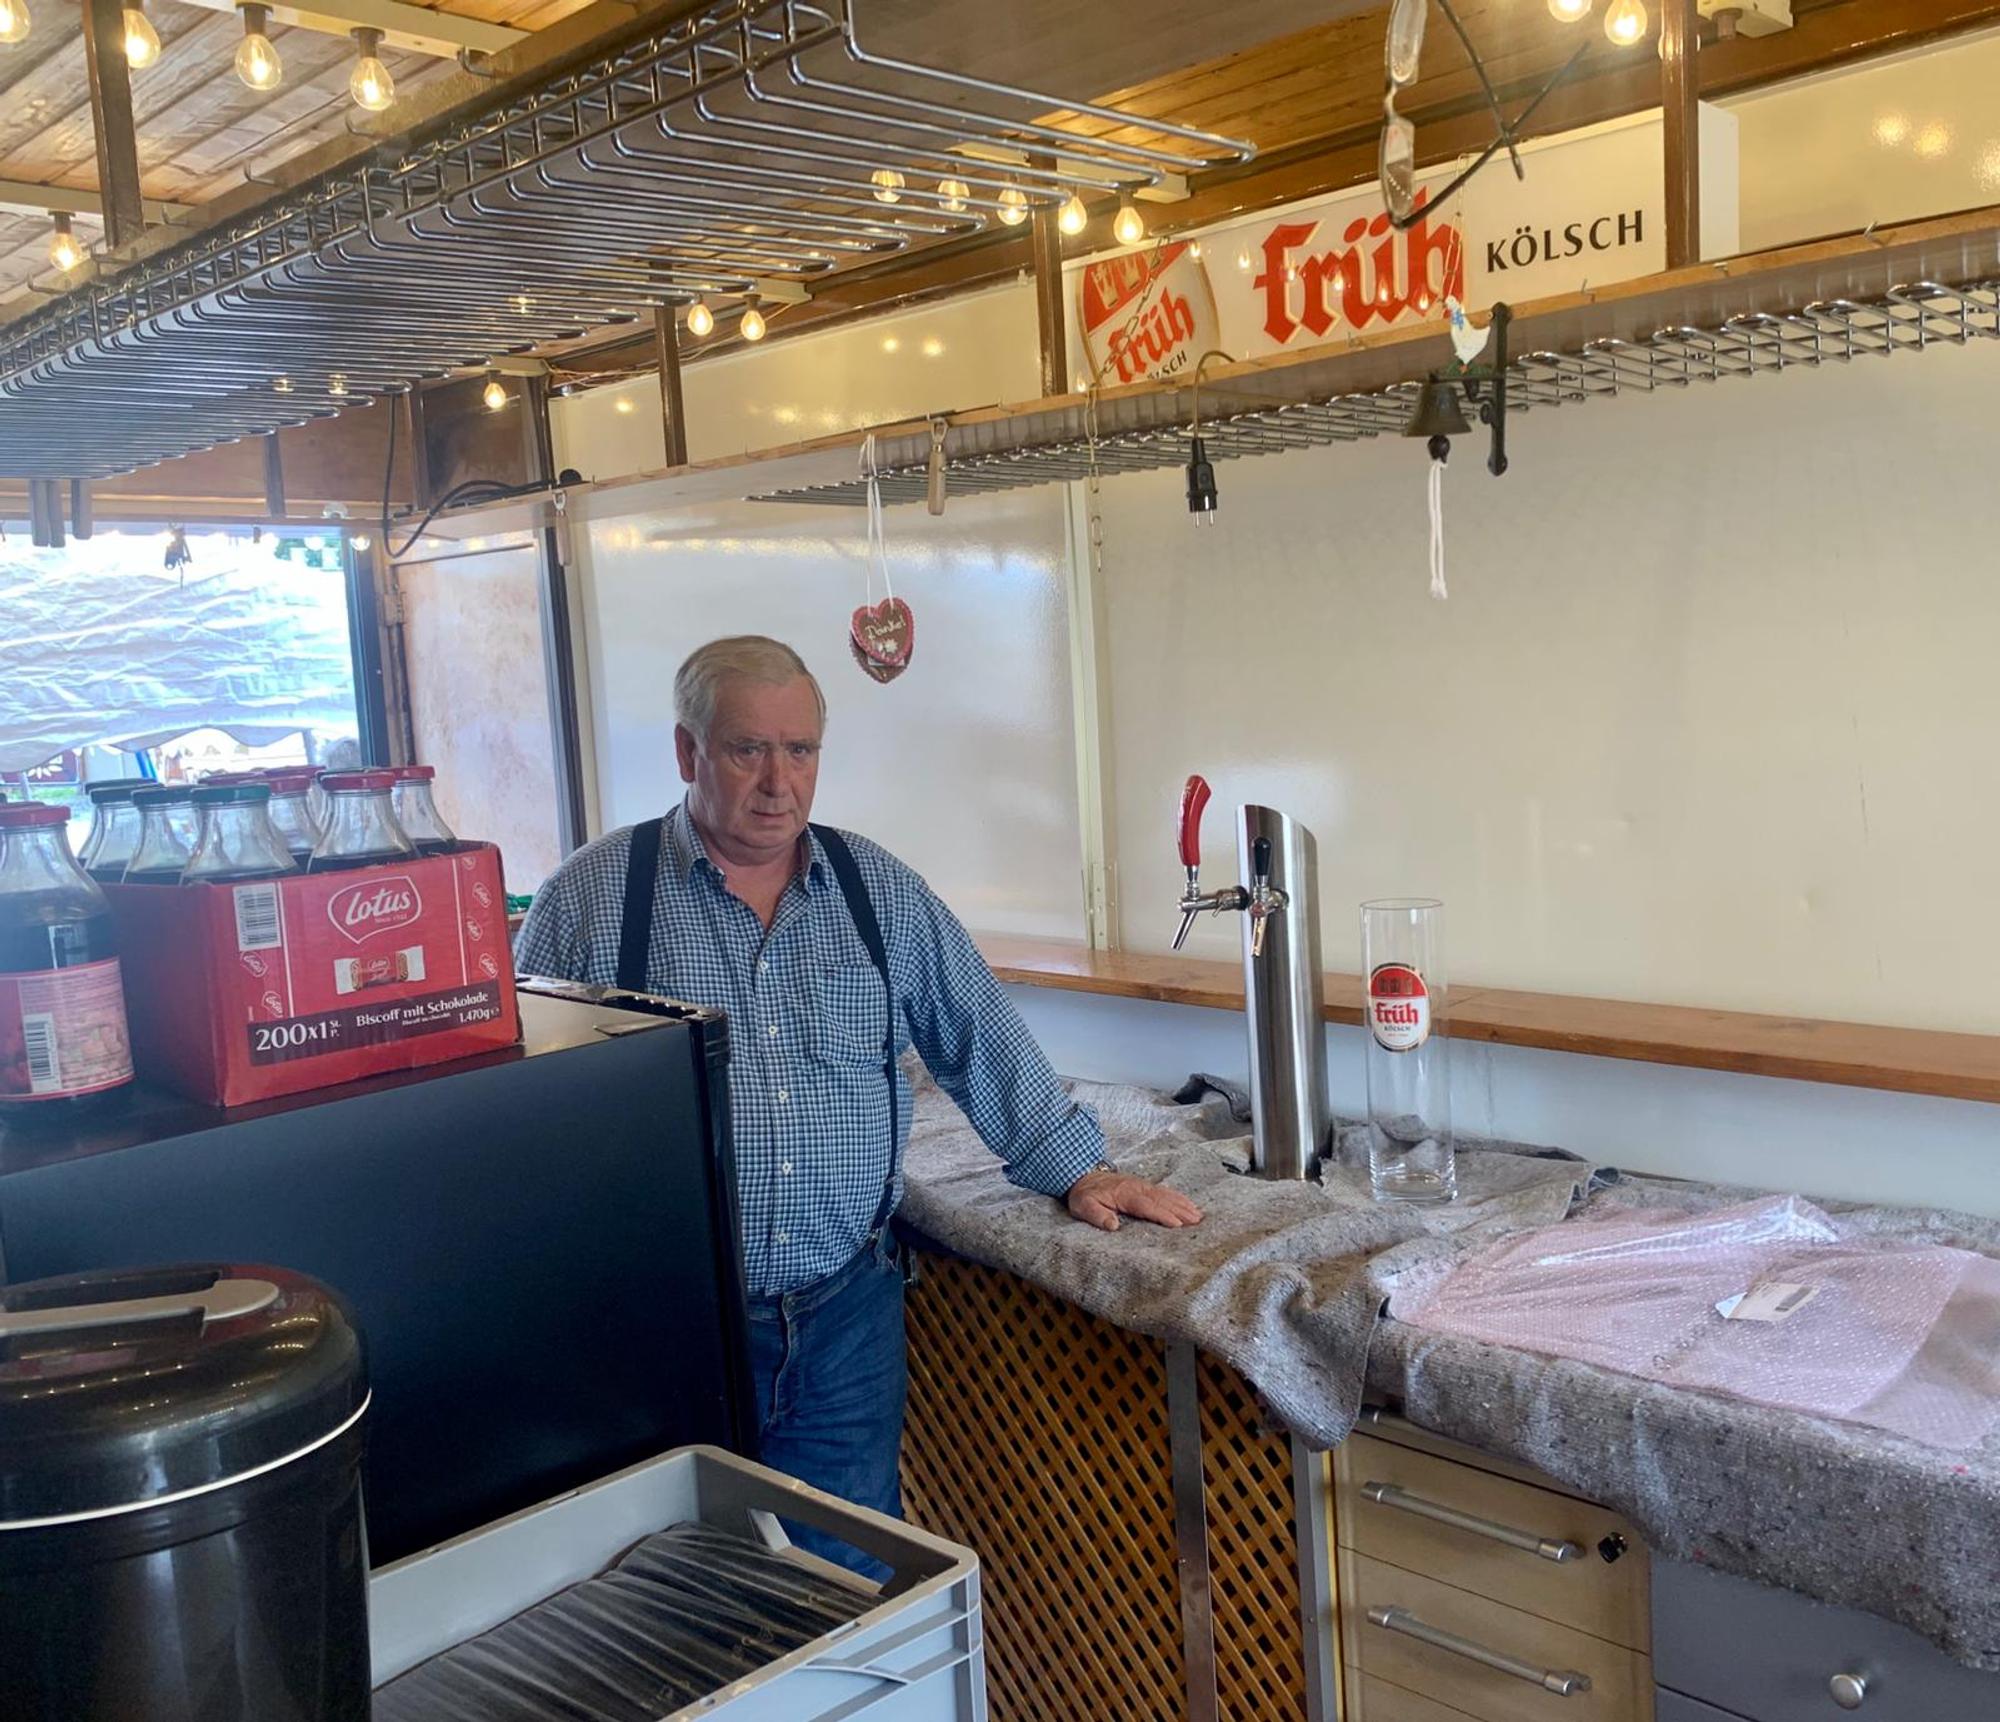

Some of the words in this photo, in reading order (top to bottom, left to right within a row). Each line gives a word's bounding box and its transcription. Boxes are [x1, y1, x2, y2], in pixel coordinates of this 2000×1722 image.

[1486, 209, 1643, 273] KÖLSCH
[345, 888, 411, 926] Lotus
[356, 1008, 400, 1027] Biscoff
[403, 1005, 425, 1019] mit
[427, 992, 489, 1013] Schokolade
[255, 1021, 327, 1051] 200x1
